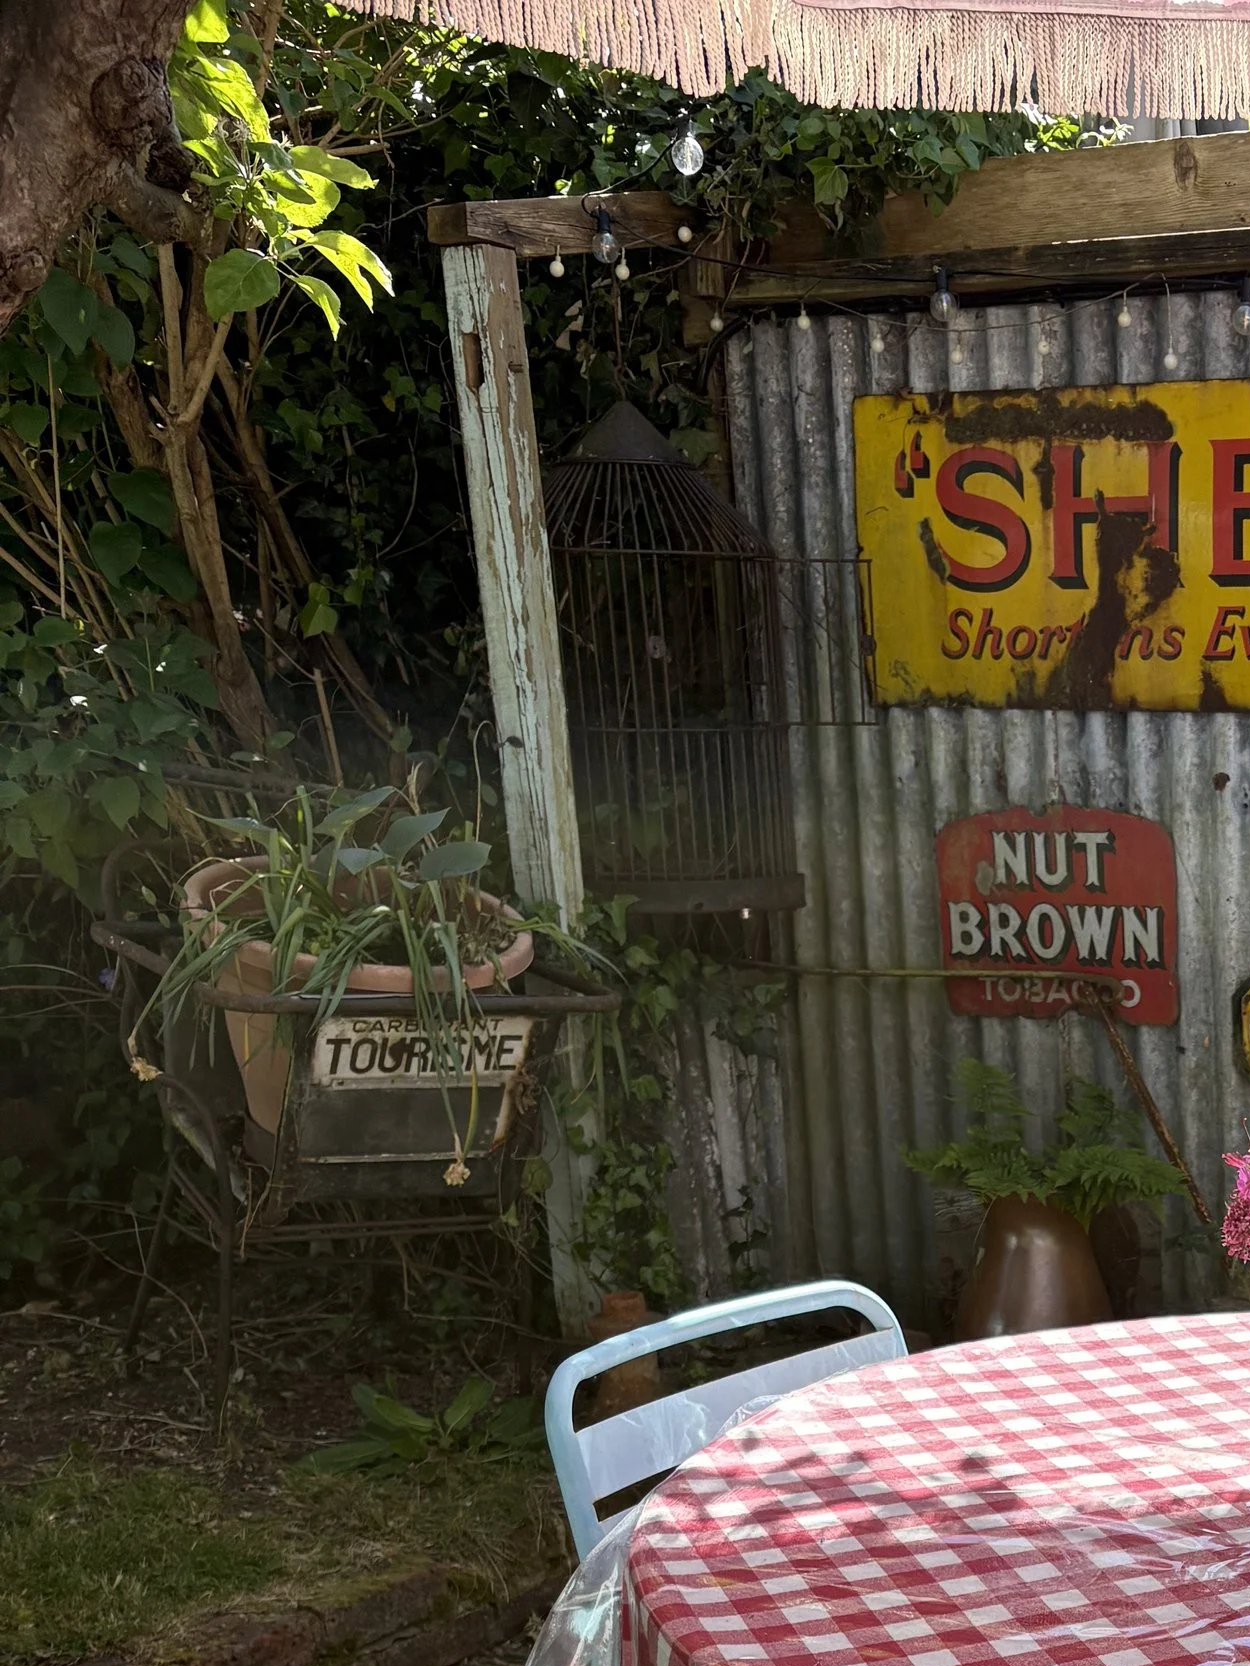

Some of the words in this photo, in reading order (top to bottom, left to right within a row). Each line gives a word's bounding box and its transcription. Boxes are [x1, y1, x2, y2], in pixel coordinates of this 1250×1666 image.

[941, 607, 1186, 661] Shortns
[992, 831, 1113, 888] NUT
[947, 902, 1163, 966] BROWN
